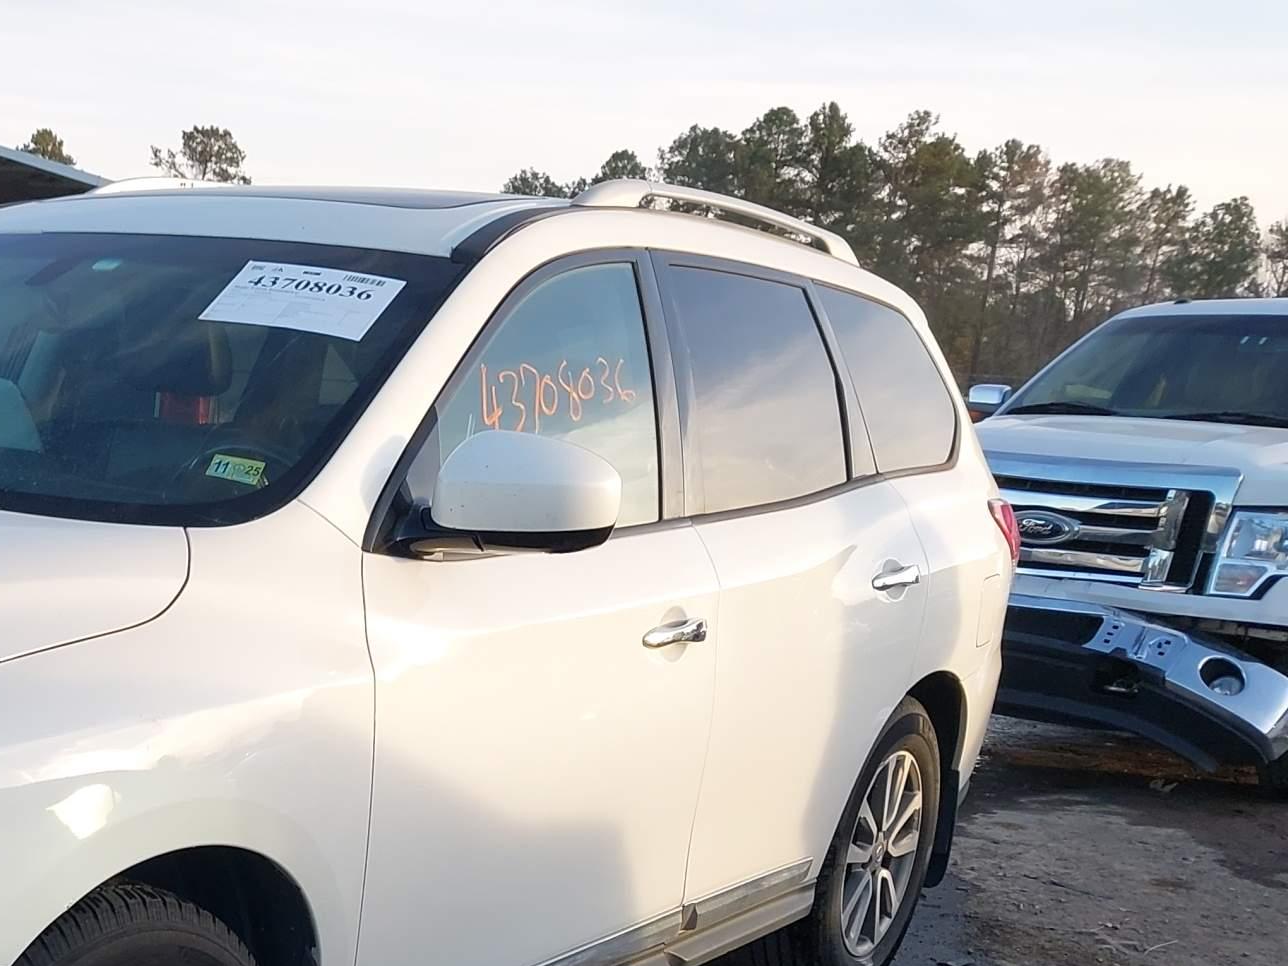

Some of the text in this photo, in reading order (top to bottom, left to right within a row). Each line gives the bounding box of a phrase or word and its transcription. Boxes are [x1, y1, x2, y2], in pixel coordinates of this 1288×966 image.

[248, 274, 375, 302] 43708036
[480, 357, 637, 434] 43708036
[213, 459, 262, 477] 11 25
[1019, 518, 1054, 535] Ford
